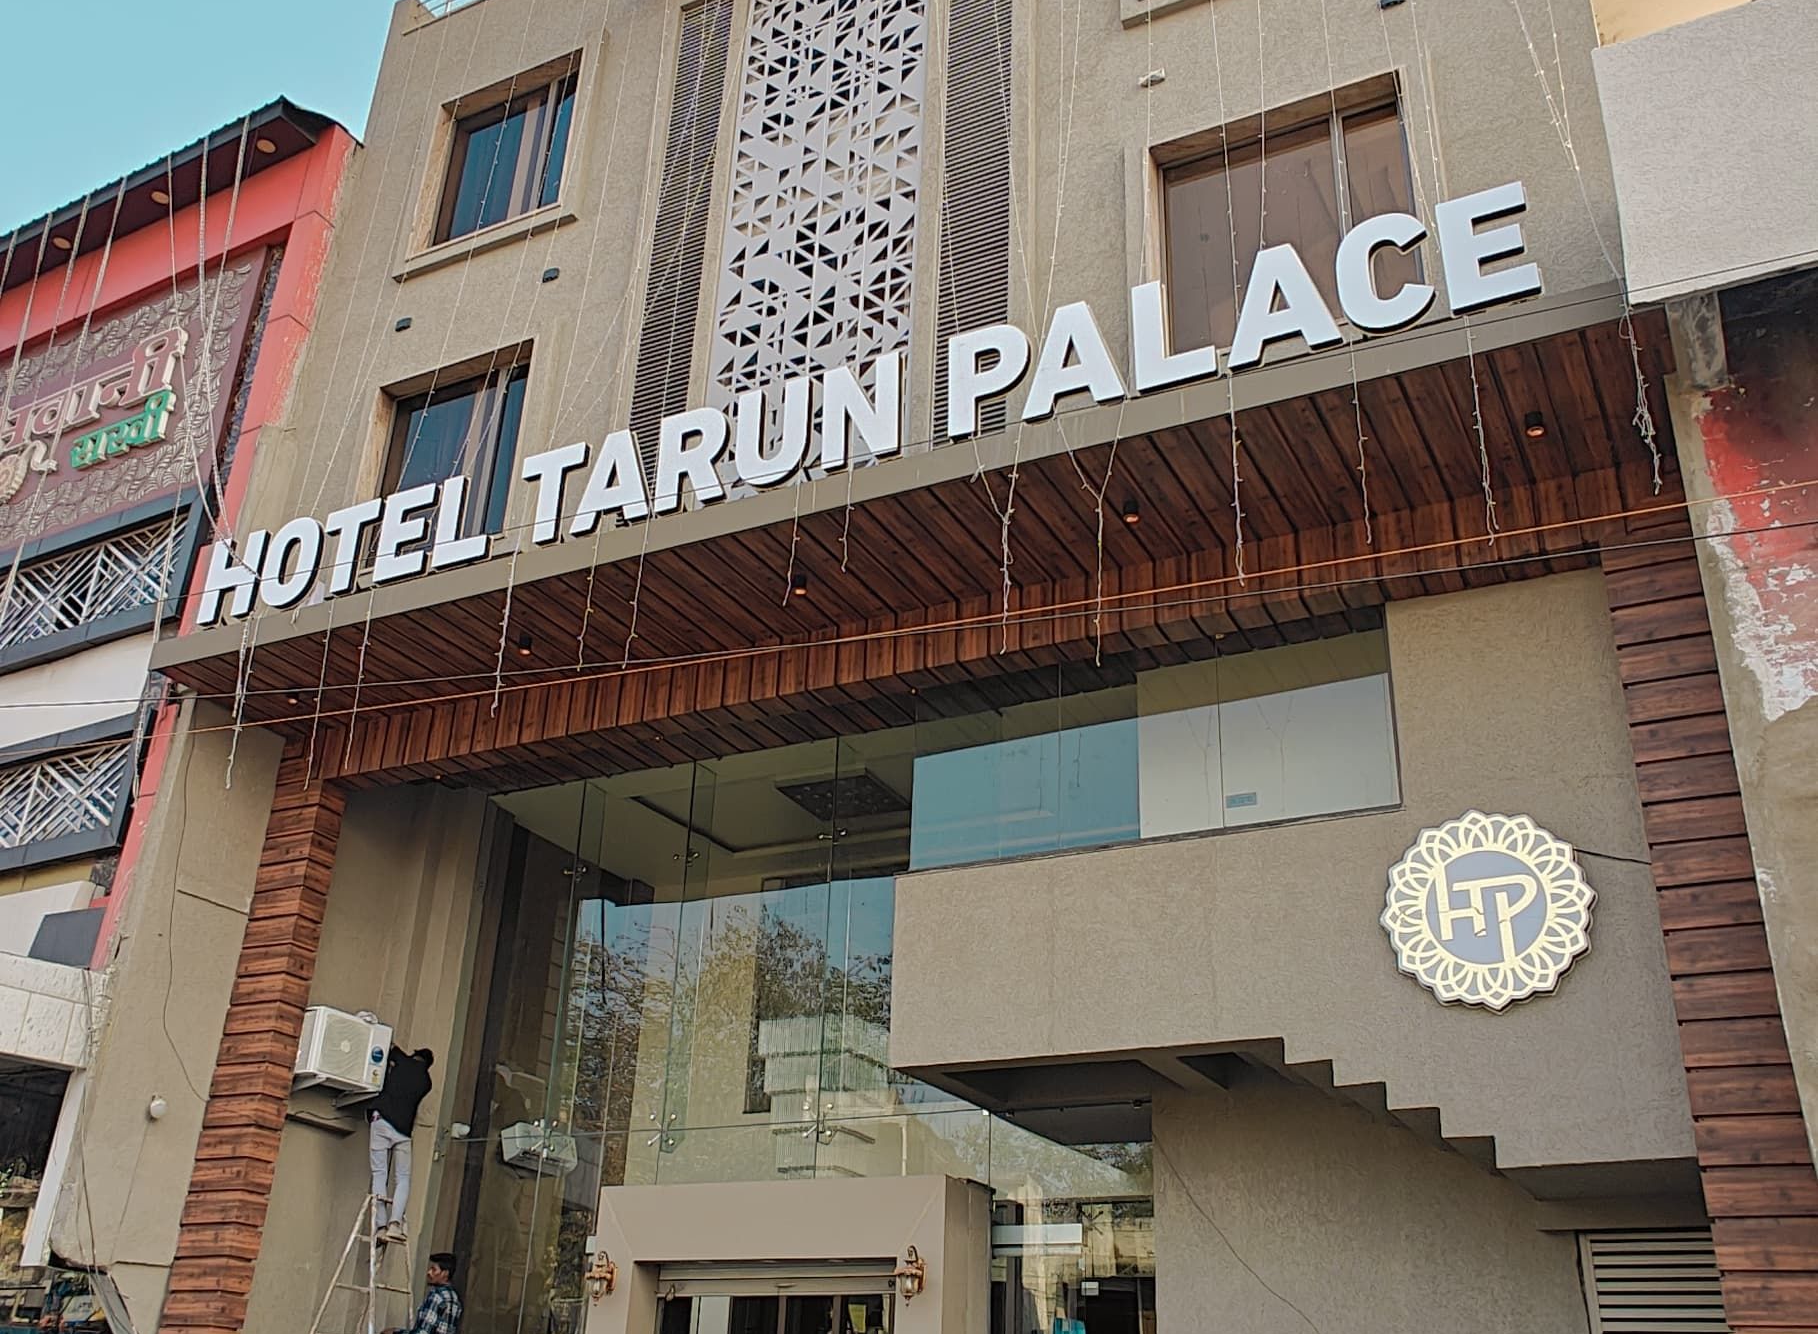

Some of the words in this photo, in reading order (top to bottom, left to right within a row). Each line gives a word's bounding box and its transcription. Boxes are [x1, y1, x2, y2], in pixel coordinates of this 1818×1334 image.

[197, 474, 492, 626] HOTEL
[522, 353, 906, 545] TARUN
[947, 181, 1543, 439] PALACE
